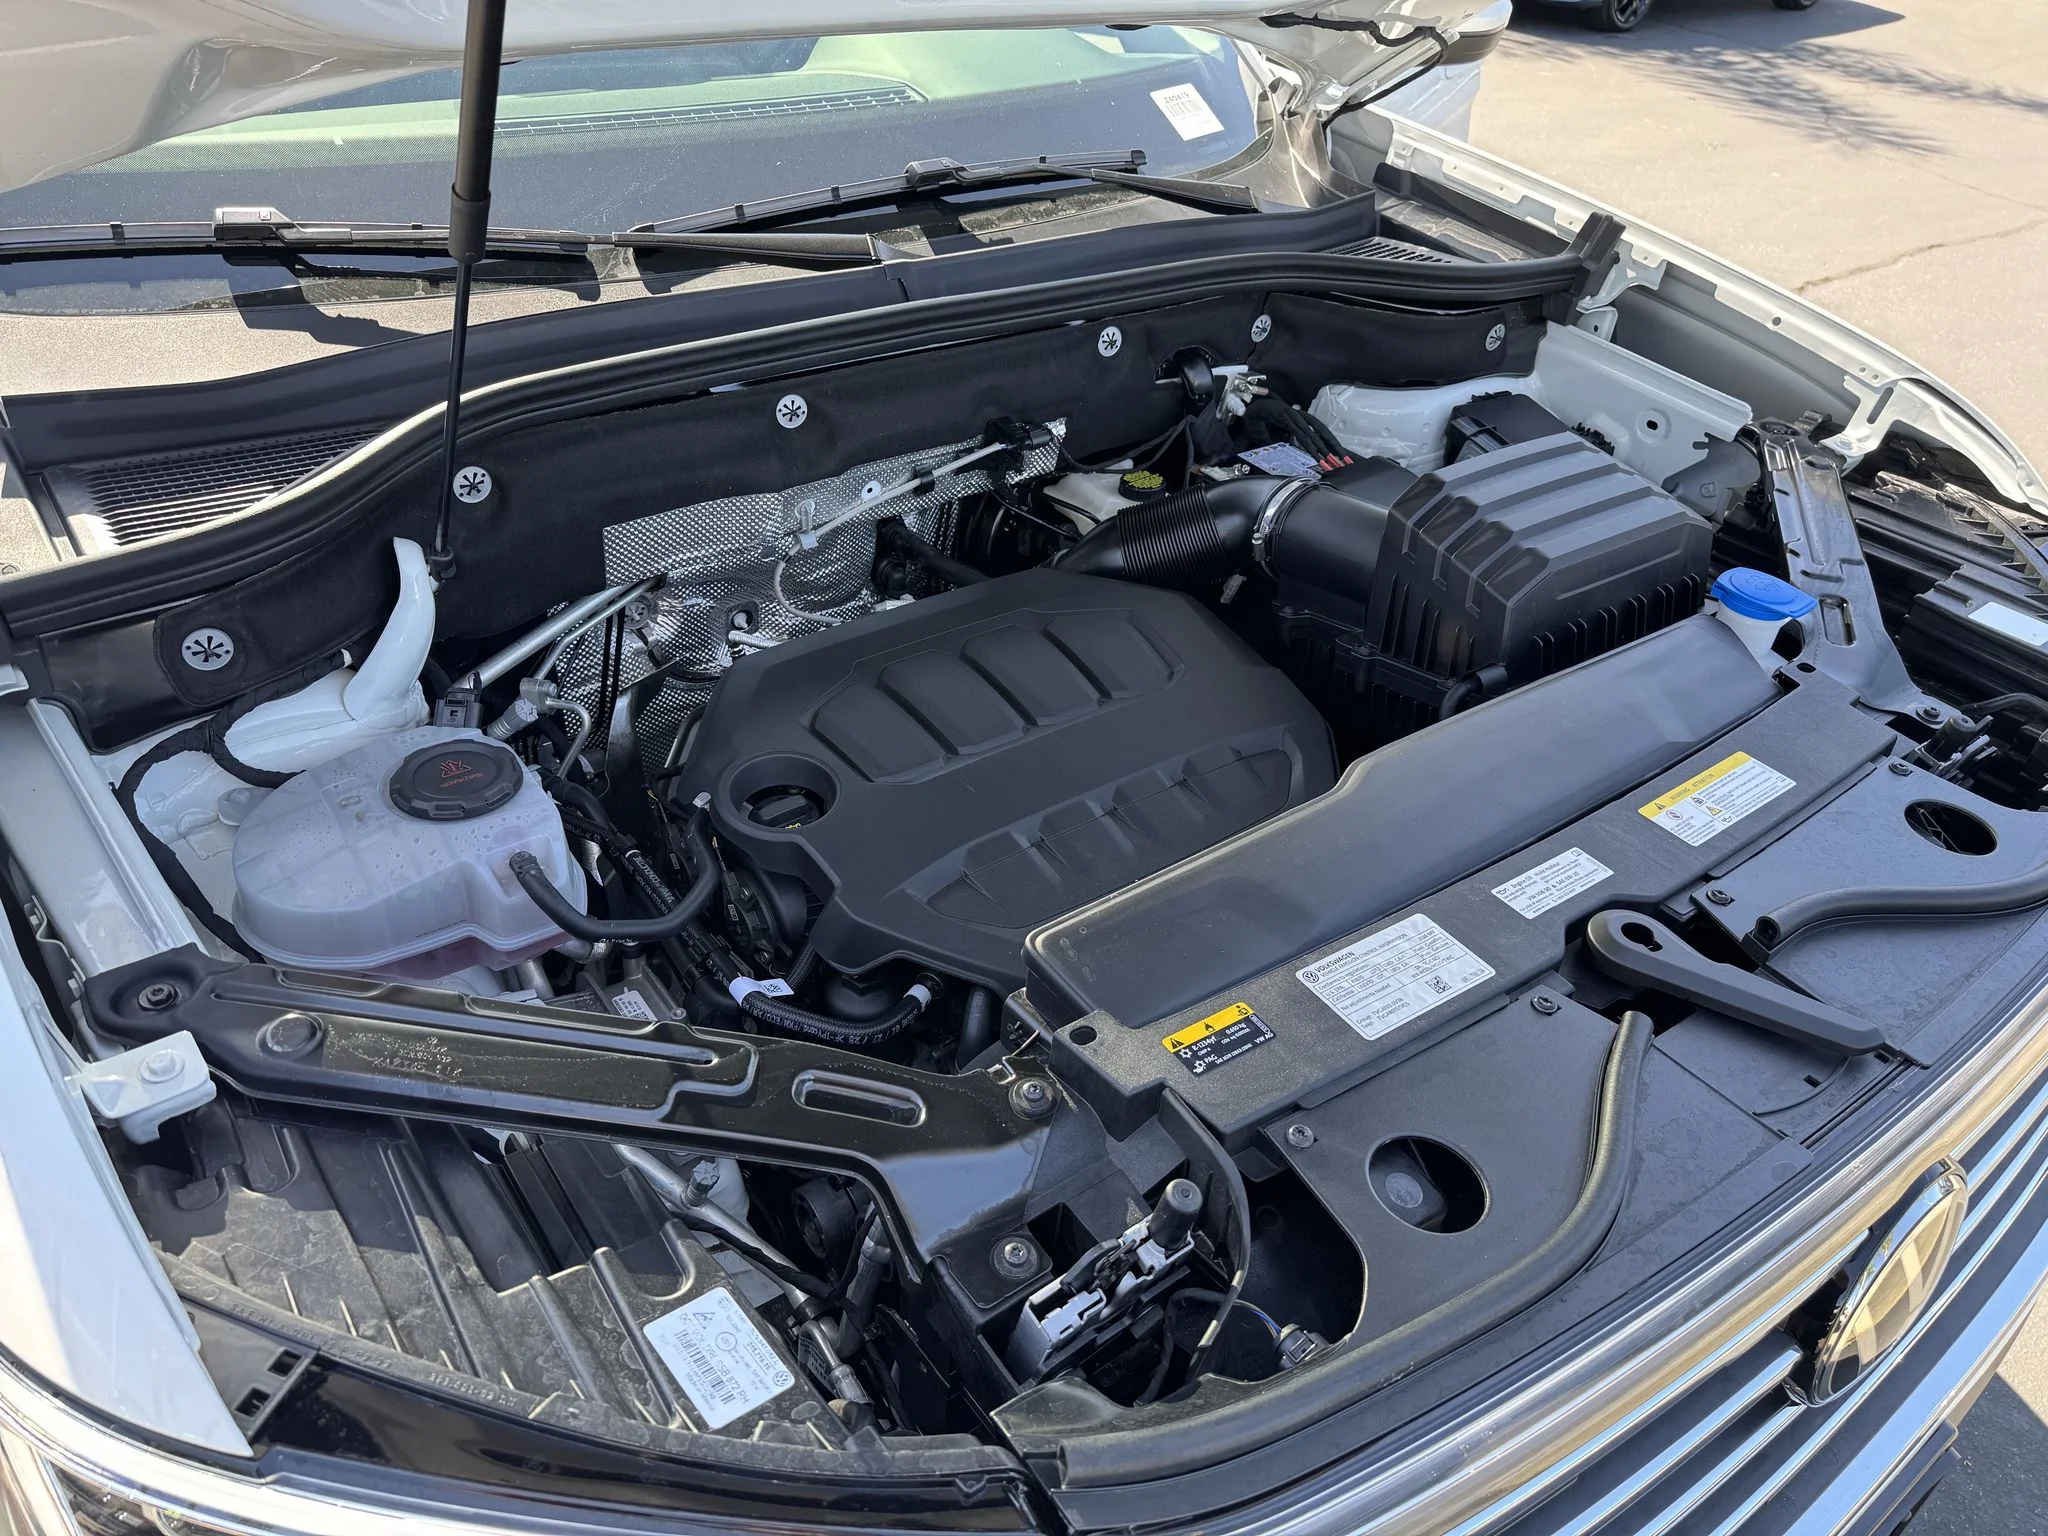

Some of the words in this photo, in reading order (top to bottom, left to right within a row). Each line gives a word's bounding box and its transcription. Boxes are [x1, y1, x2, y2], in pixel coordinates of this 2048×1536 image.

[1314, 950, 1356, 973] VOLKSWAGEN
[1319, 966, 1339, 978] VEHICLE
[1337, 956, 1360, 969] EMISSION
[1357, 946, 1379, 959] CONTROL
[1377, 932, 1408, 949] INFORMATION
[1317, 977, 1340, 990] Conforms
[1190, 1035, 1218, 1052] R-1234yf
[1254, 1036, 1266, 1044] VW
[1262, 1031, 1274, 1039] AG
[1203, 1053, 1218, 1063] PAG
[725, 1375, 741, 1391] 872
[736, 1389, 750, 1404] RH
